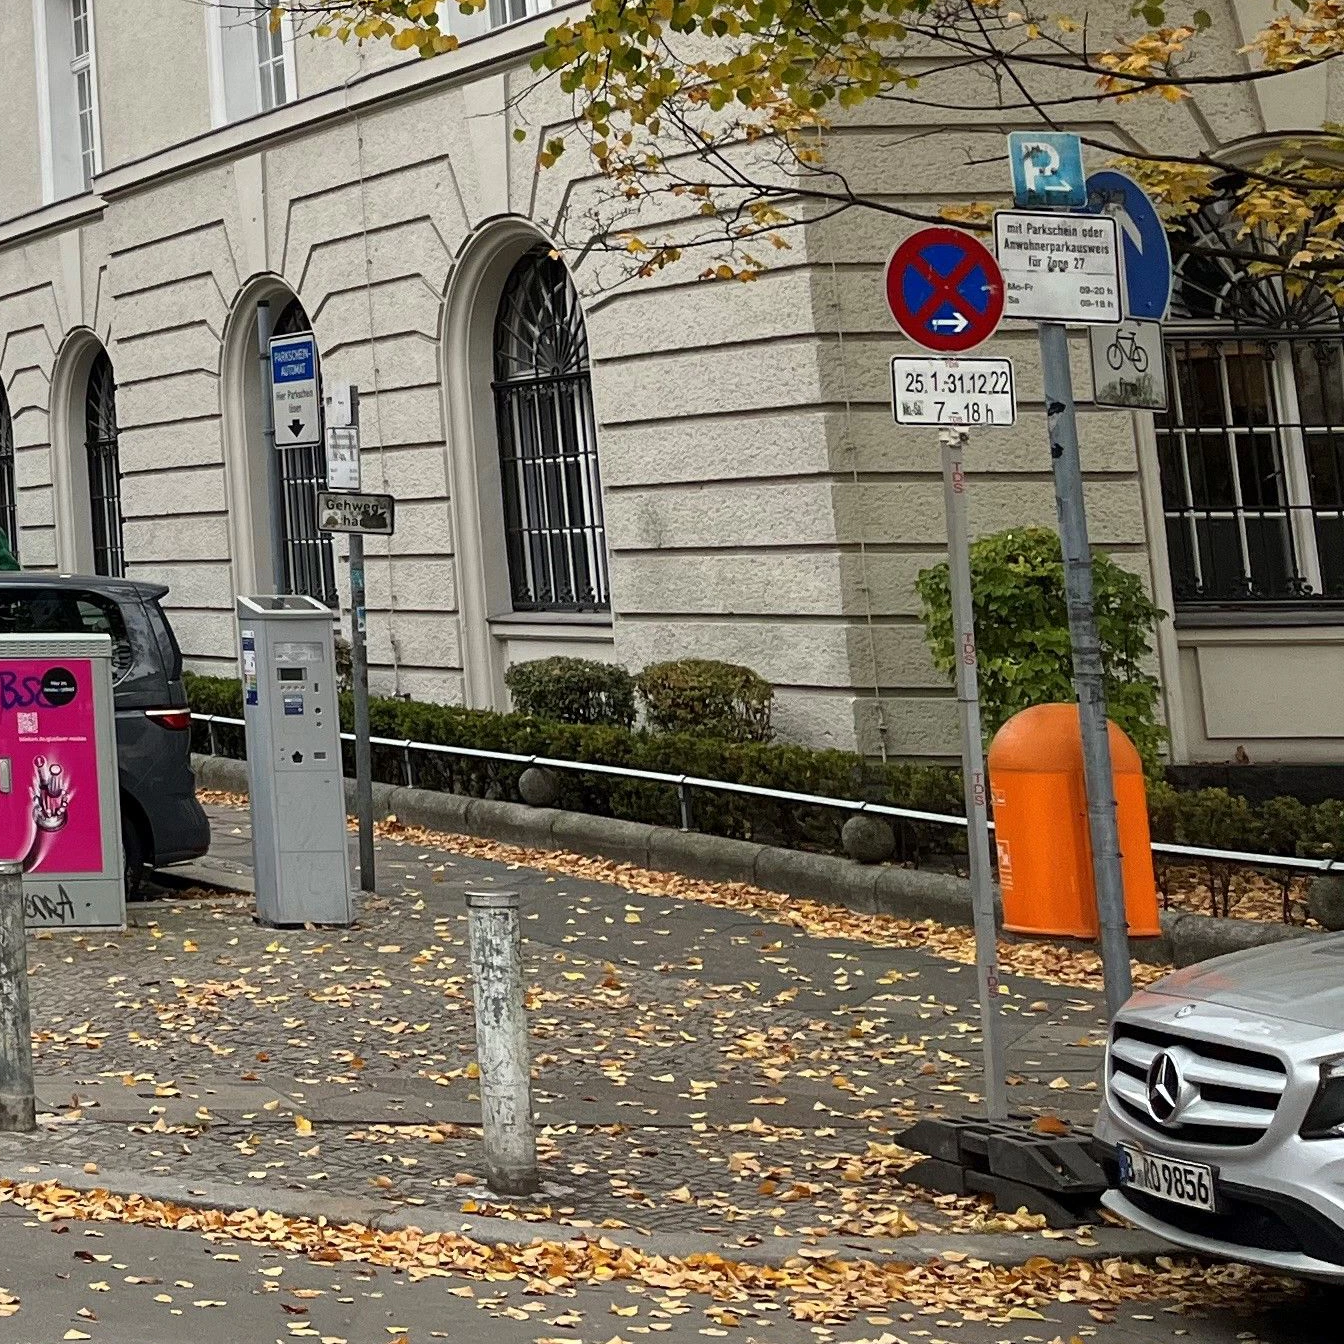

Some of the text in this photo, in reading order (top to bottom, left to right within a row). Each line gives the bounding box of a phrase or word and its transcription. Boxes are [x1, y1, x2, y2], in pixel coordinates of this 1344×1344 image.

[1007, 222, 1104, 238] mit Parkschein oder
[1004, 237, 1110, 254] Anwohnerparkausweis
[1028, 255, 1042, 267] für
[1073, 257, 1085, 269] 27
[934, 401, 945, 422] 7
[963, 402, 981, 422] 18
[985, 403, 993, 423] h
[1162, 1163, 1209, 1205] 9856
